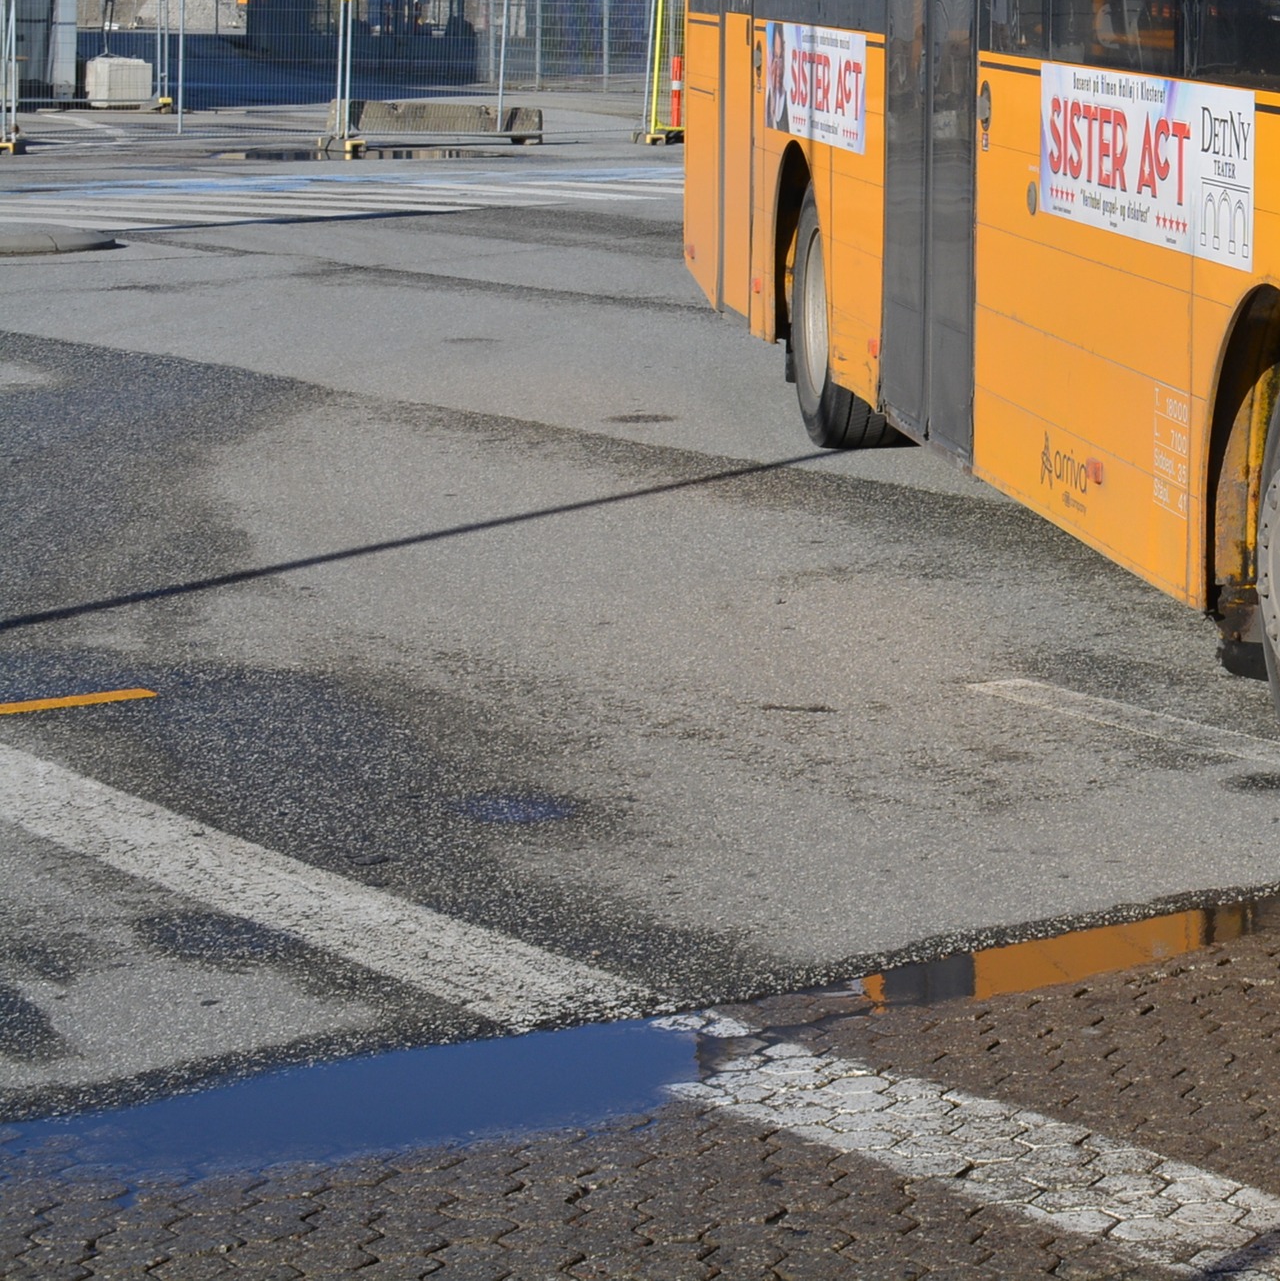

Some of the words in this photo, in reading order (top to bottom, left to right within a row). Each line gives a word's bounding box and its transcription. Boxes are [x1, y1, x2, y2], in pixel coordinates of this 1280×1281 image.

[790, 49, 831, 114] SISTER
[834, 55, 862, 121] ACT
[1073, 71, 1092, 93] Baseret
[1049, 94, 1129, 193] SISTER
[1136, 110, 1192, 206] ACT
[1213, 159, 1236, 180] TEATER
